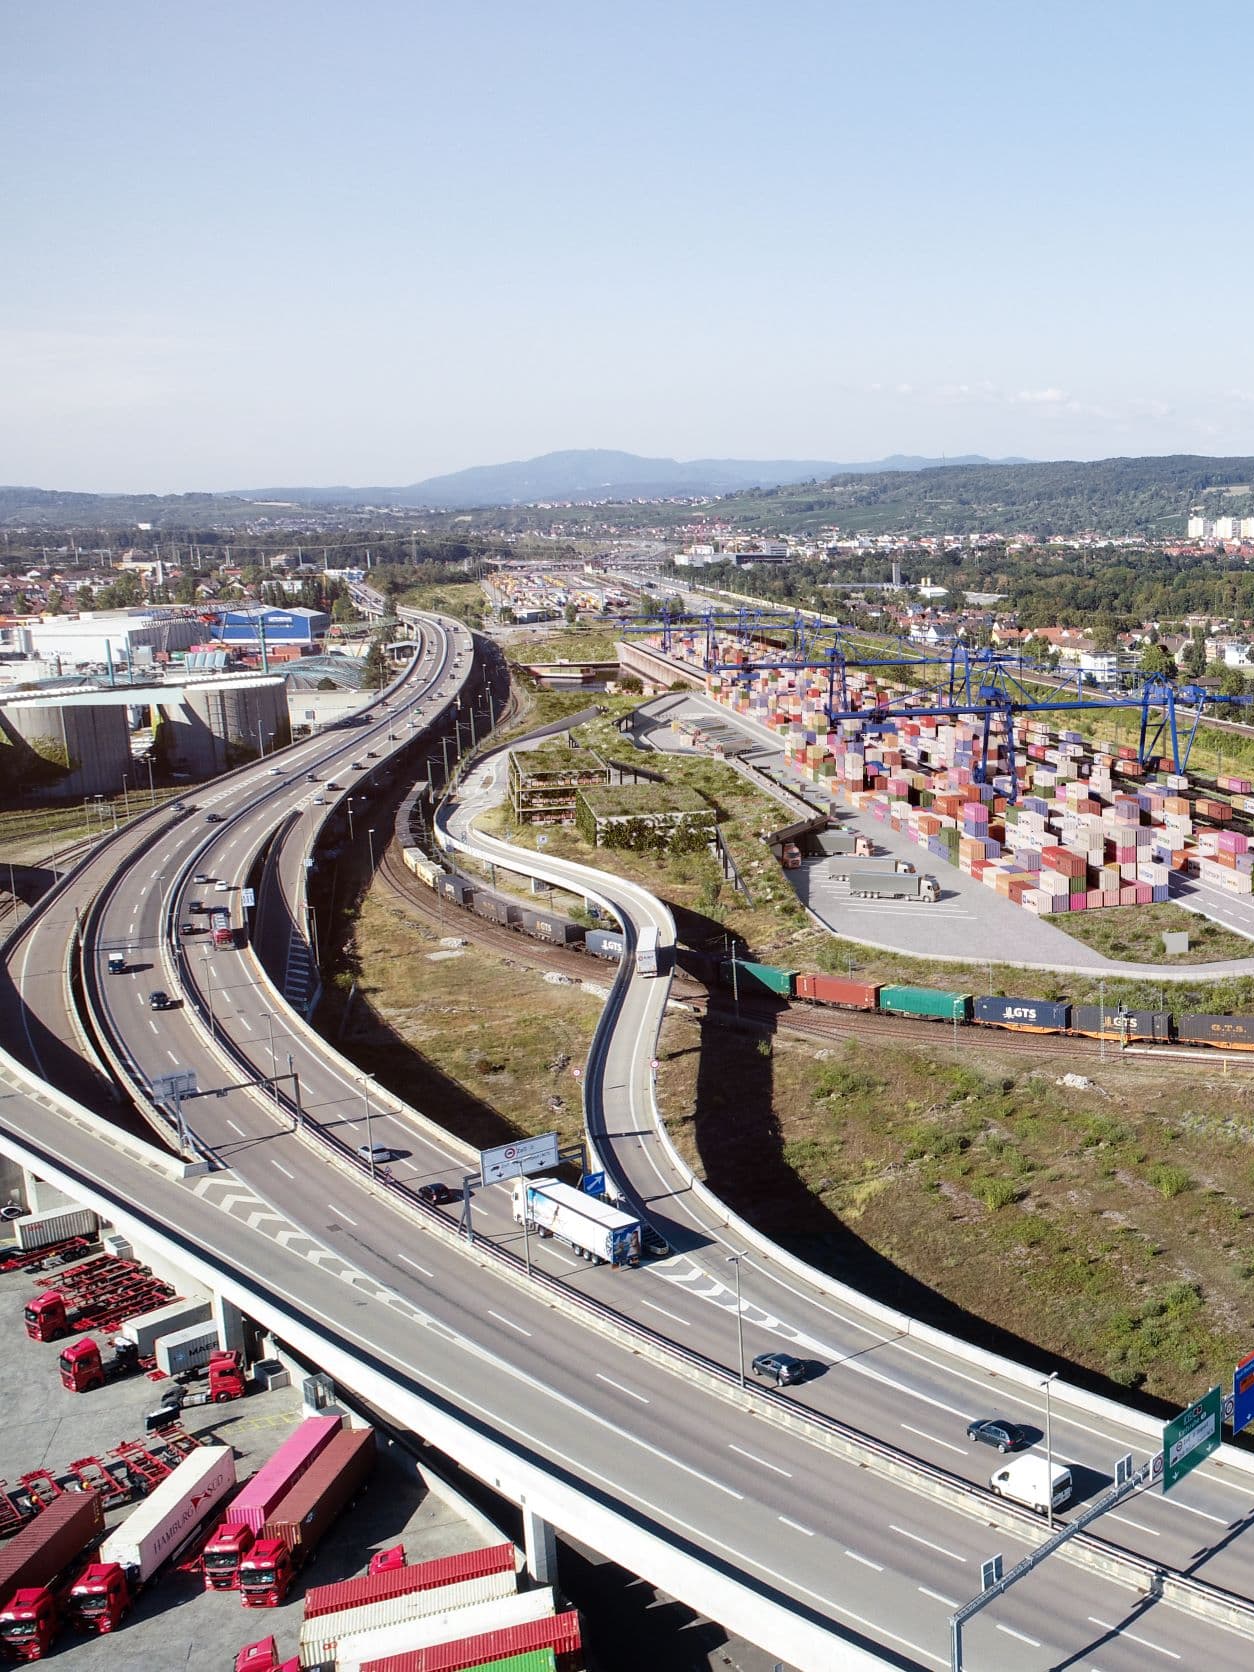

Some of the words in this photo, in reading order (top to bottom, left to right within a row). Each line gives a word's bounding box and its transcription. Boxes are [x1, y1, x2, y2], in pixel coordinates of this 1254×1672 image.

[608, 941, 622, 952] GTS
[1013, 1007, 1037, 1019] GTS
[1113, 1017, 1138, 1028] GTS
[153, 1505, 194, 1555] HAMBURG
